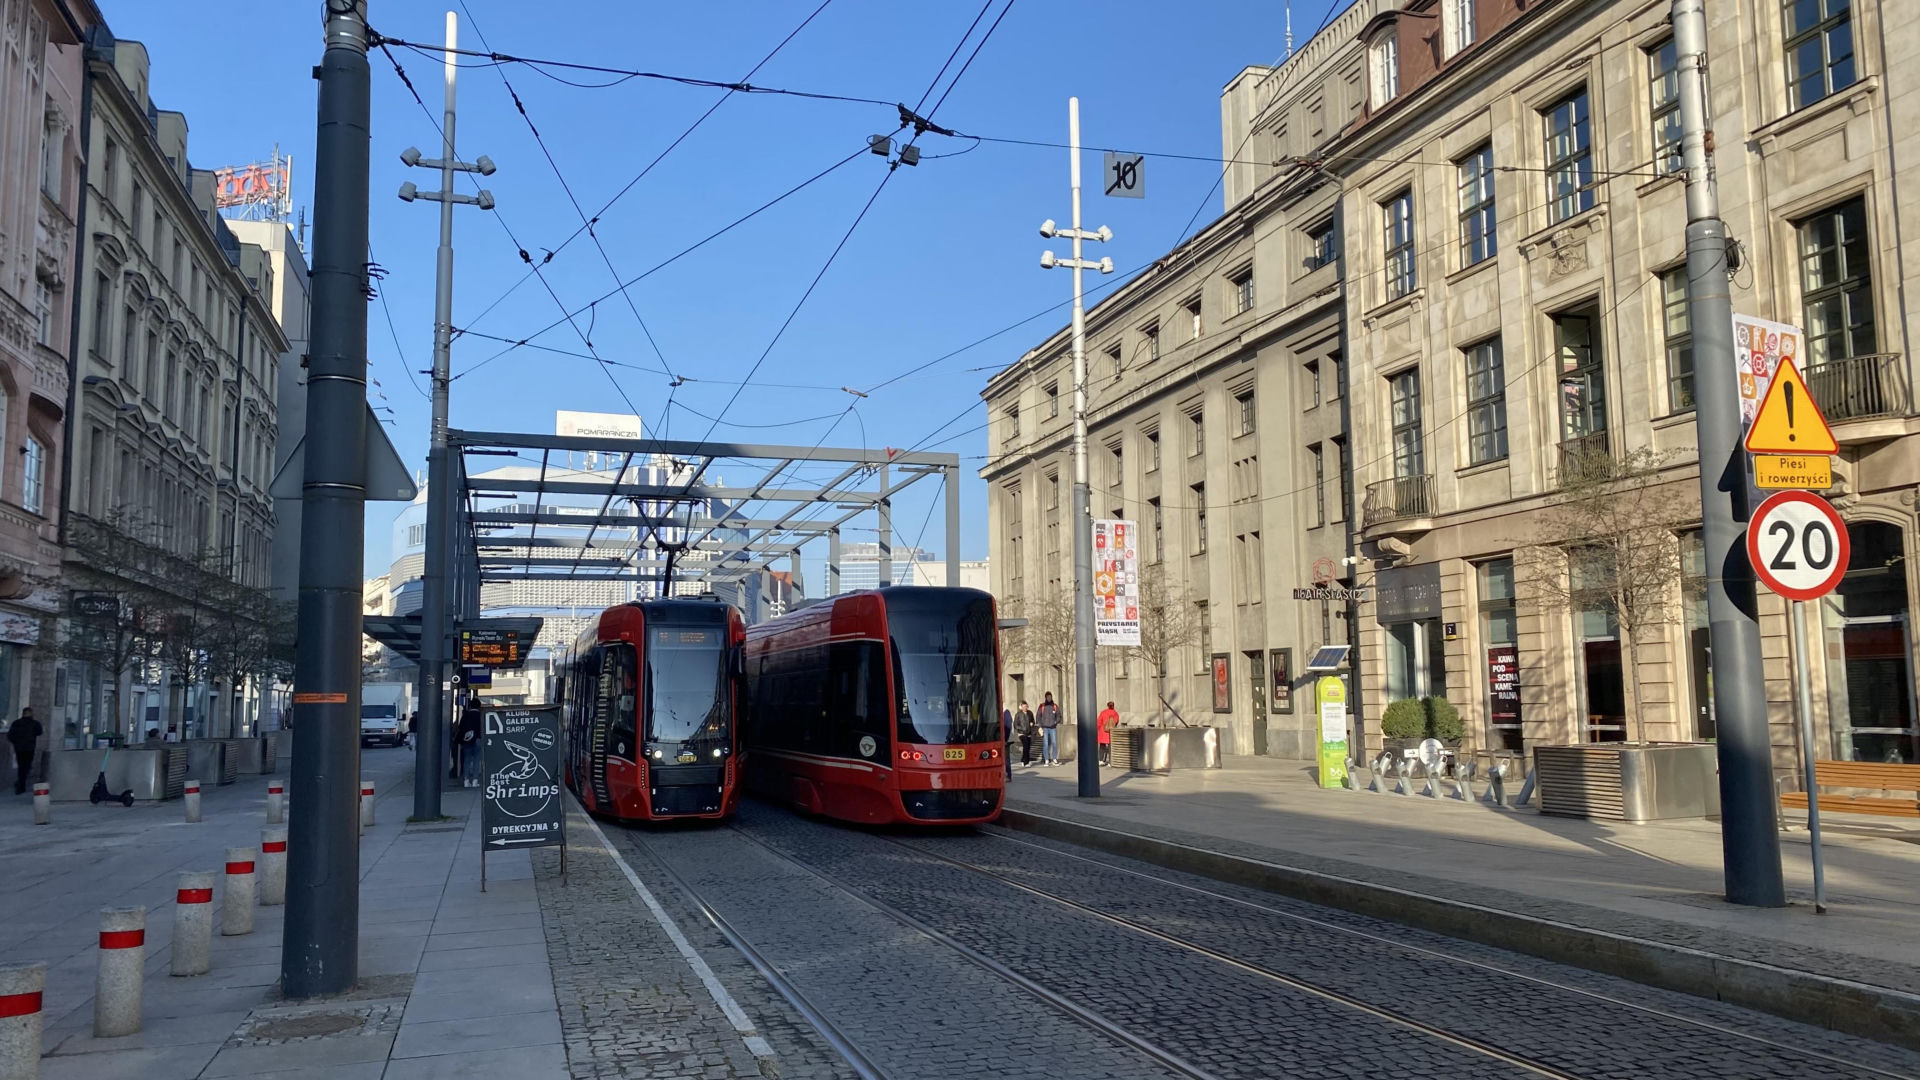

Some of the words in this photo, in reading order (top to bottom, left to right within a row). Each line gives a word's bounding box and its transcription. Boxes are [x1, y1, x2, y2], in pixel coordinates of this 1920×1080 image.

[1112, 161, 1137, 190] 10
[1780, 458, 1806, 469] Piesi
[1760, 472, 1763, 483] i
[1768, 472, 1828, 486] rowerzyści
[1768, 520, 1833, 570] 20
[1497, 655, 1515, 663] KAWA
[505, 717, 540, 725] GALERIA
[485, 783, 559, 799] Shrimps
[492, 823, 548, 834] DYREKCYJNA
